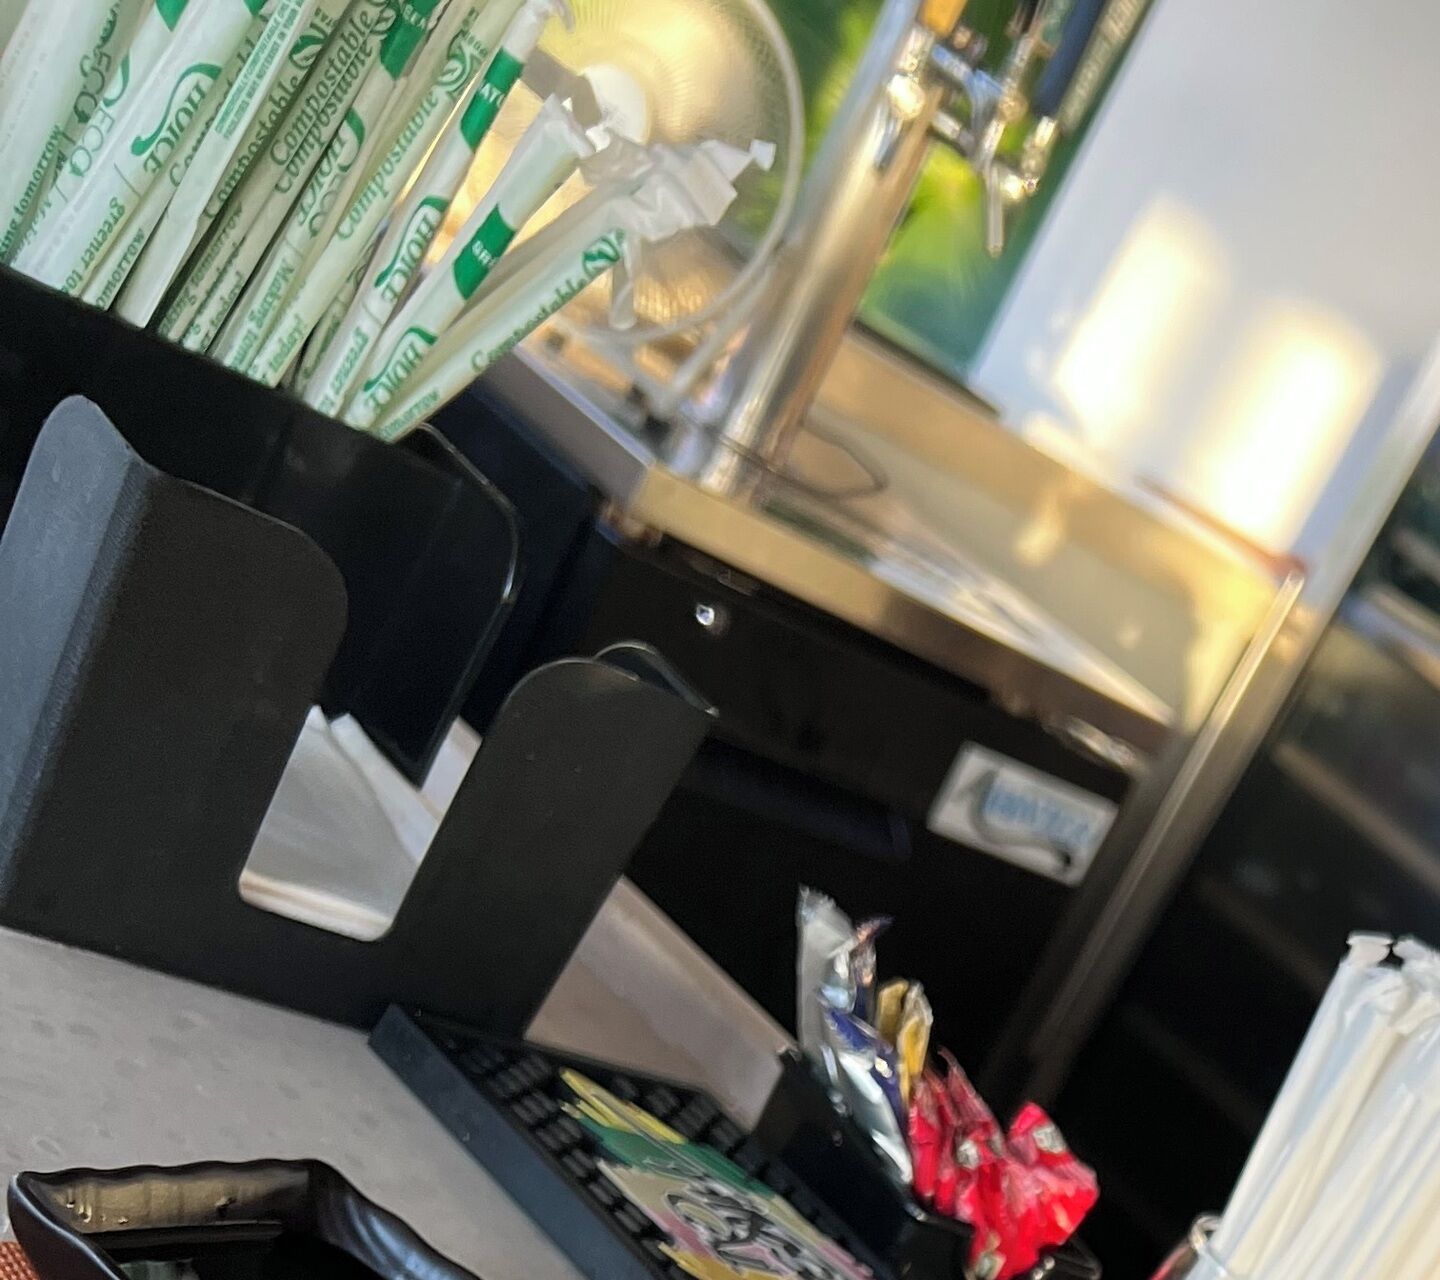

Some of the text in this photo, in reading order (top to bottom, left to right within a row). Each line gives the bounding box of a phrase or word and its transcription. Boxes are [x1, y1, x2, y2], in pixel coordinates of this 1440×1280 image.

[270, 9, 375, 167] Compostable
[13, 124, 63, 218] tomorrow
[80, 196, 126, 270] greener
[96, 227, 146, 309] omorrow
